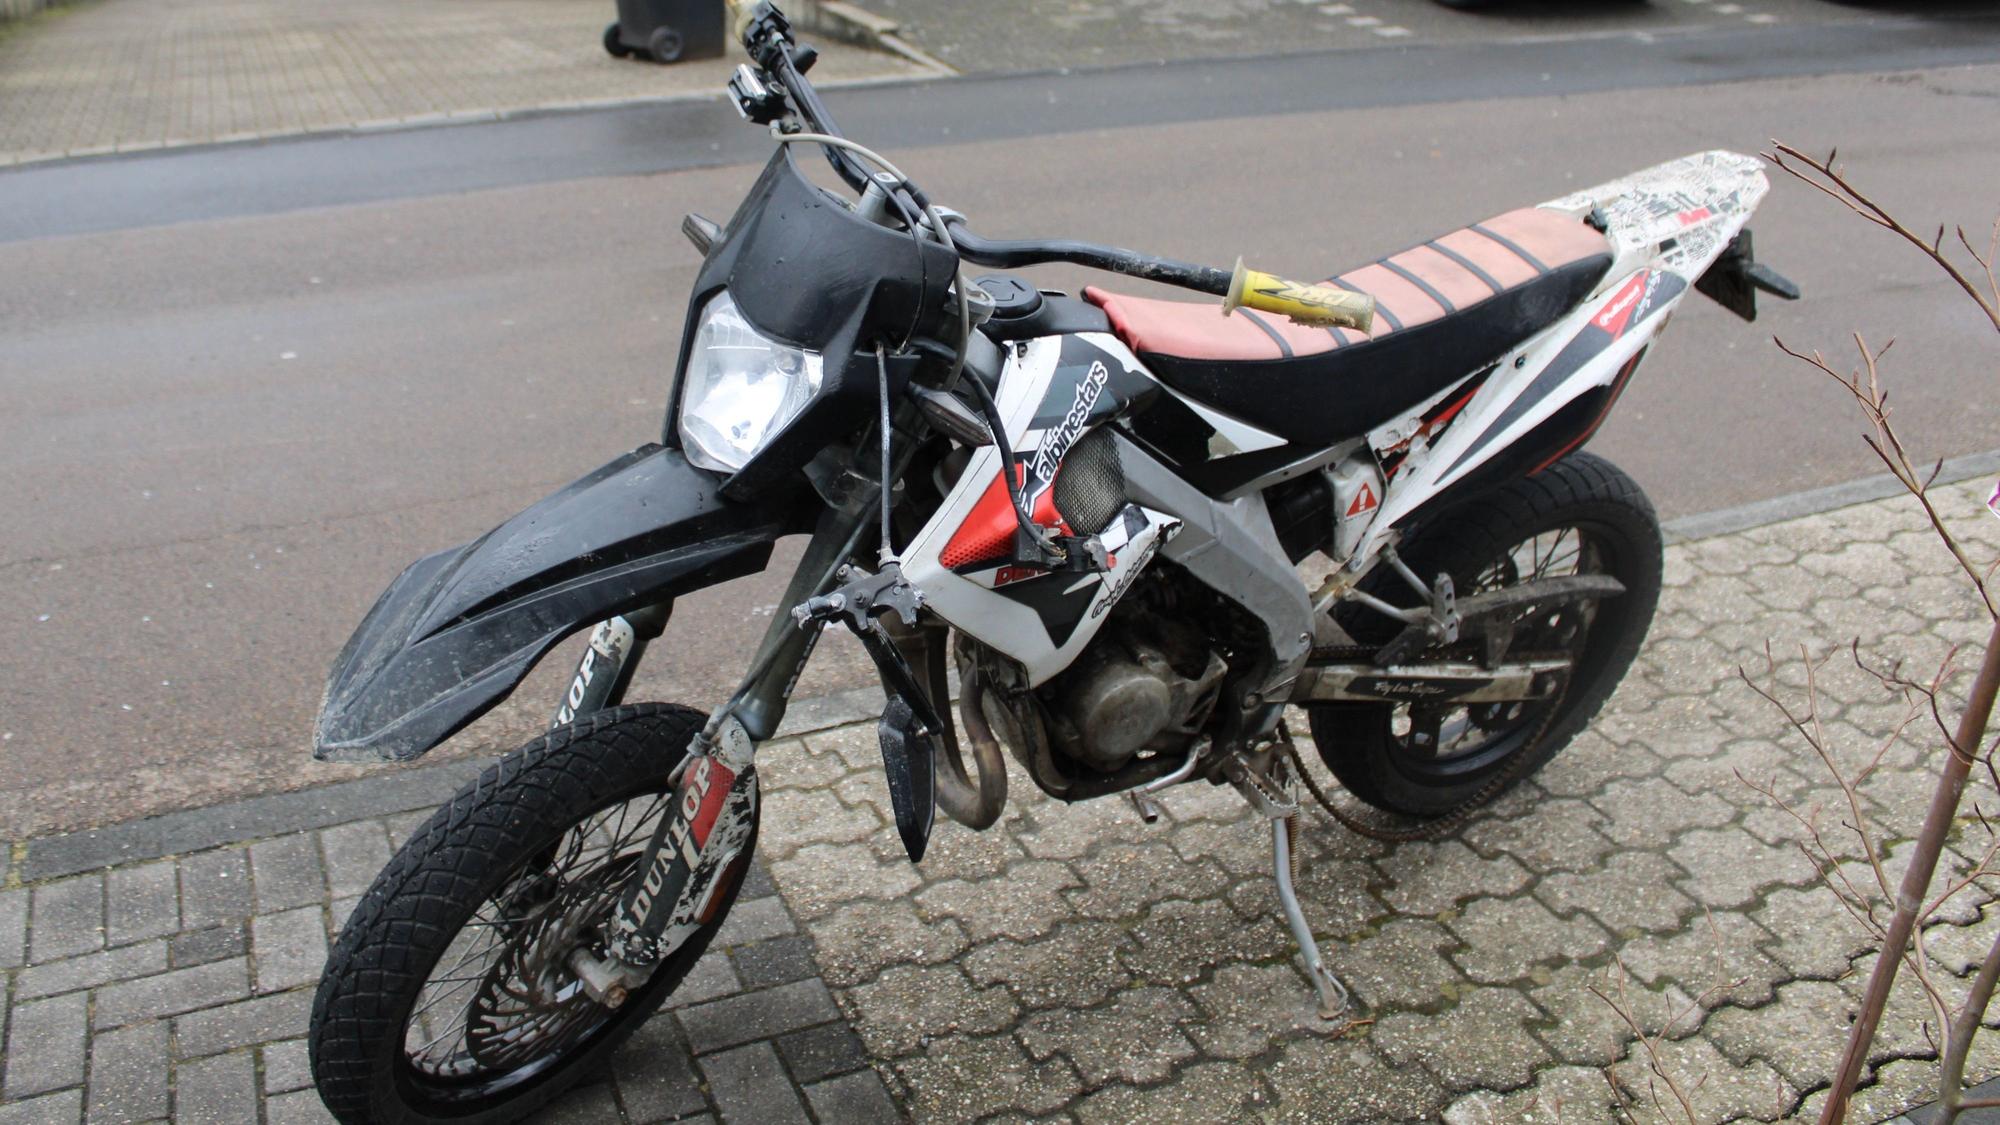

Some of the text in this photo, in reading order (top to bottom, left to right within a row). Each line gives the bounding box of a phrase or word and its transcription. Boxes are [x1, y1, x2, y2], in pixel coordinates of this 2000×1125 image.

[1038, 361, 1107, 481] alpinestars
[554, 647, 595, 728] LOP
[629, 756, 711, 928] DUNLOP
